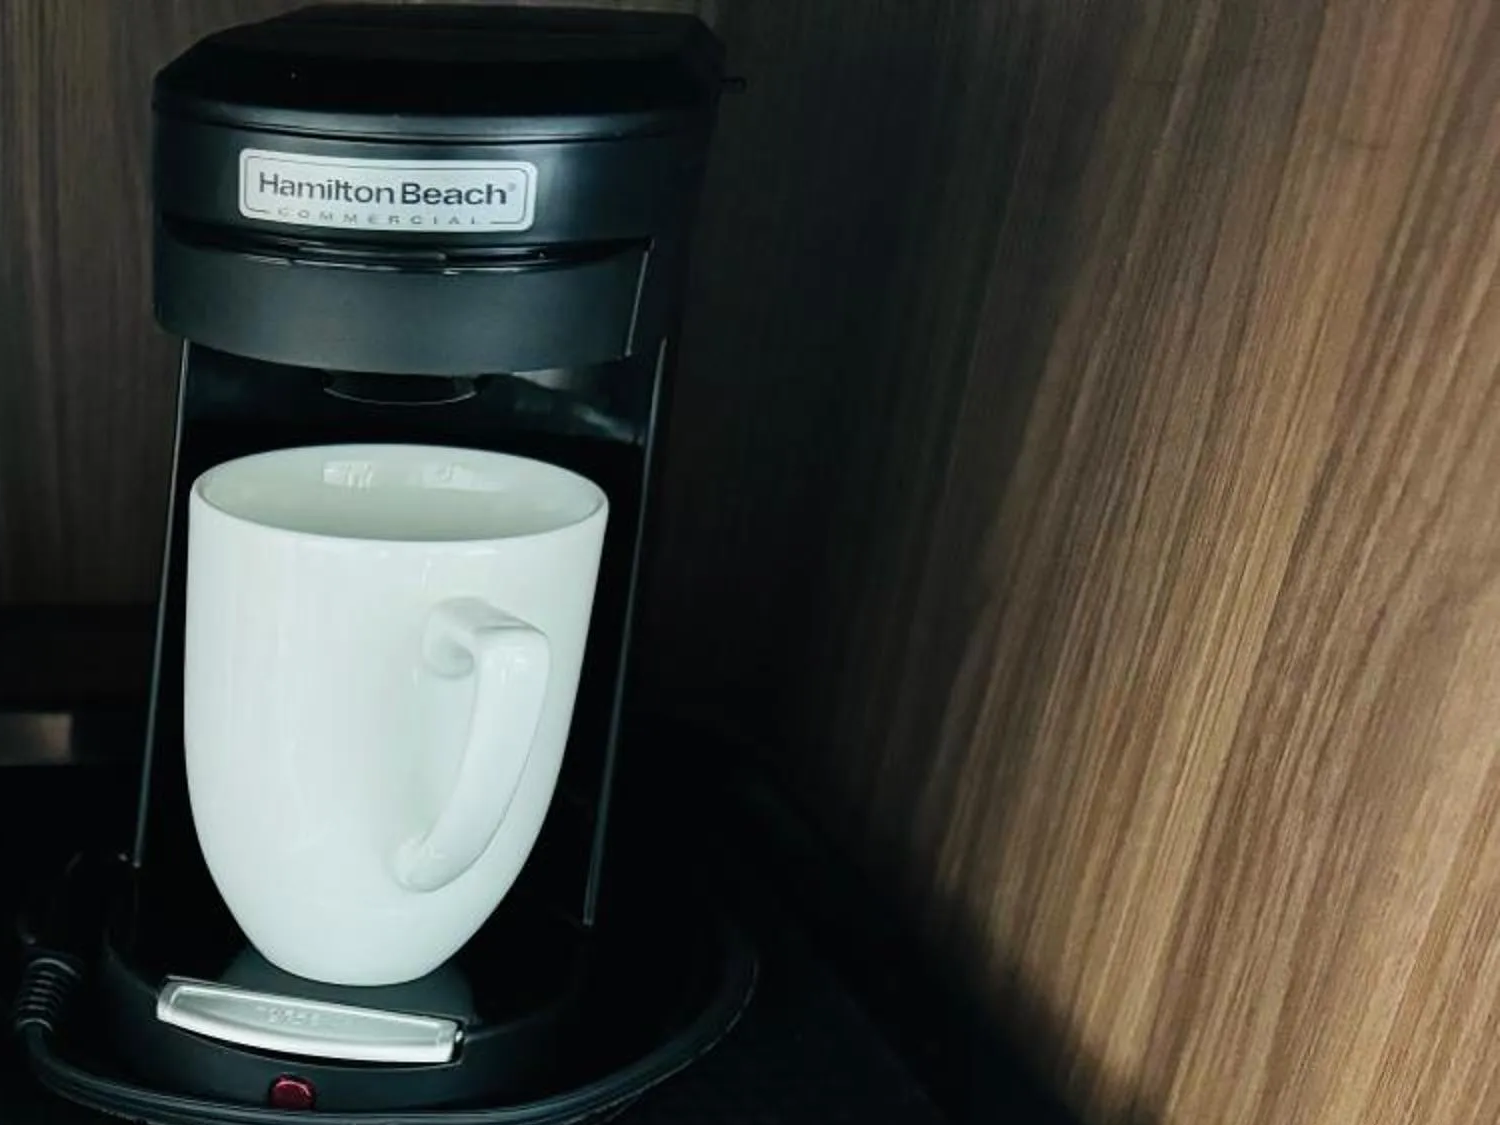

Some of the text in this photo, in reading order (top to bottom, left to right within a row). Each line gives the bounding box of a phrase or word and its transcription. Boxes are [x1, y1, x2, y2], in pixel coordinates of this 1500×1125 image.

[258, 171, 508, 205] Hamilton Beach
[277, 207, 477, 226] COMMERCIAL
